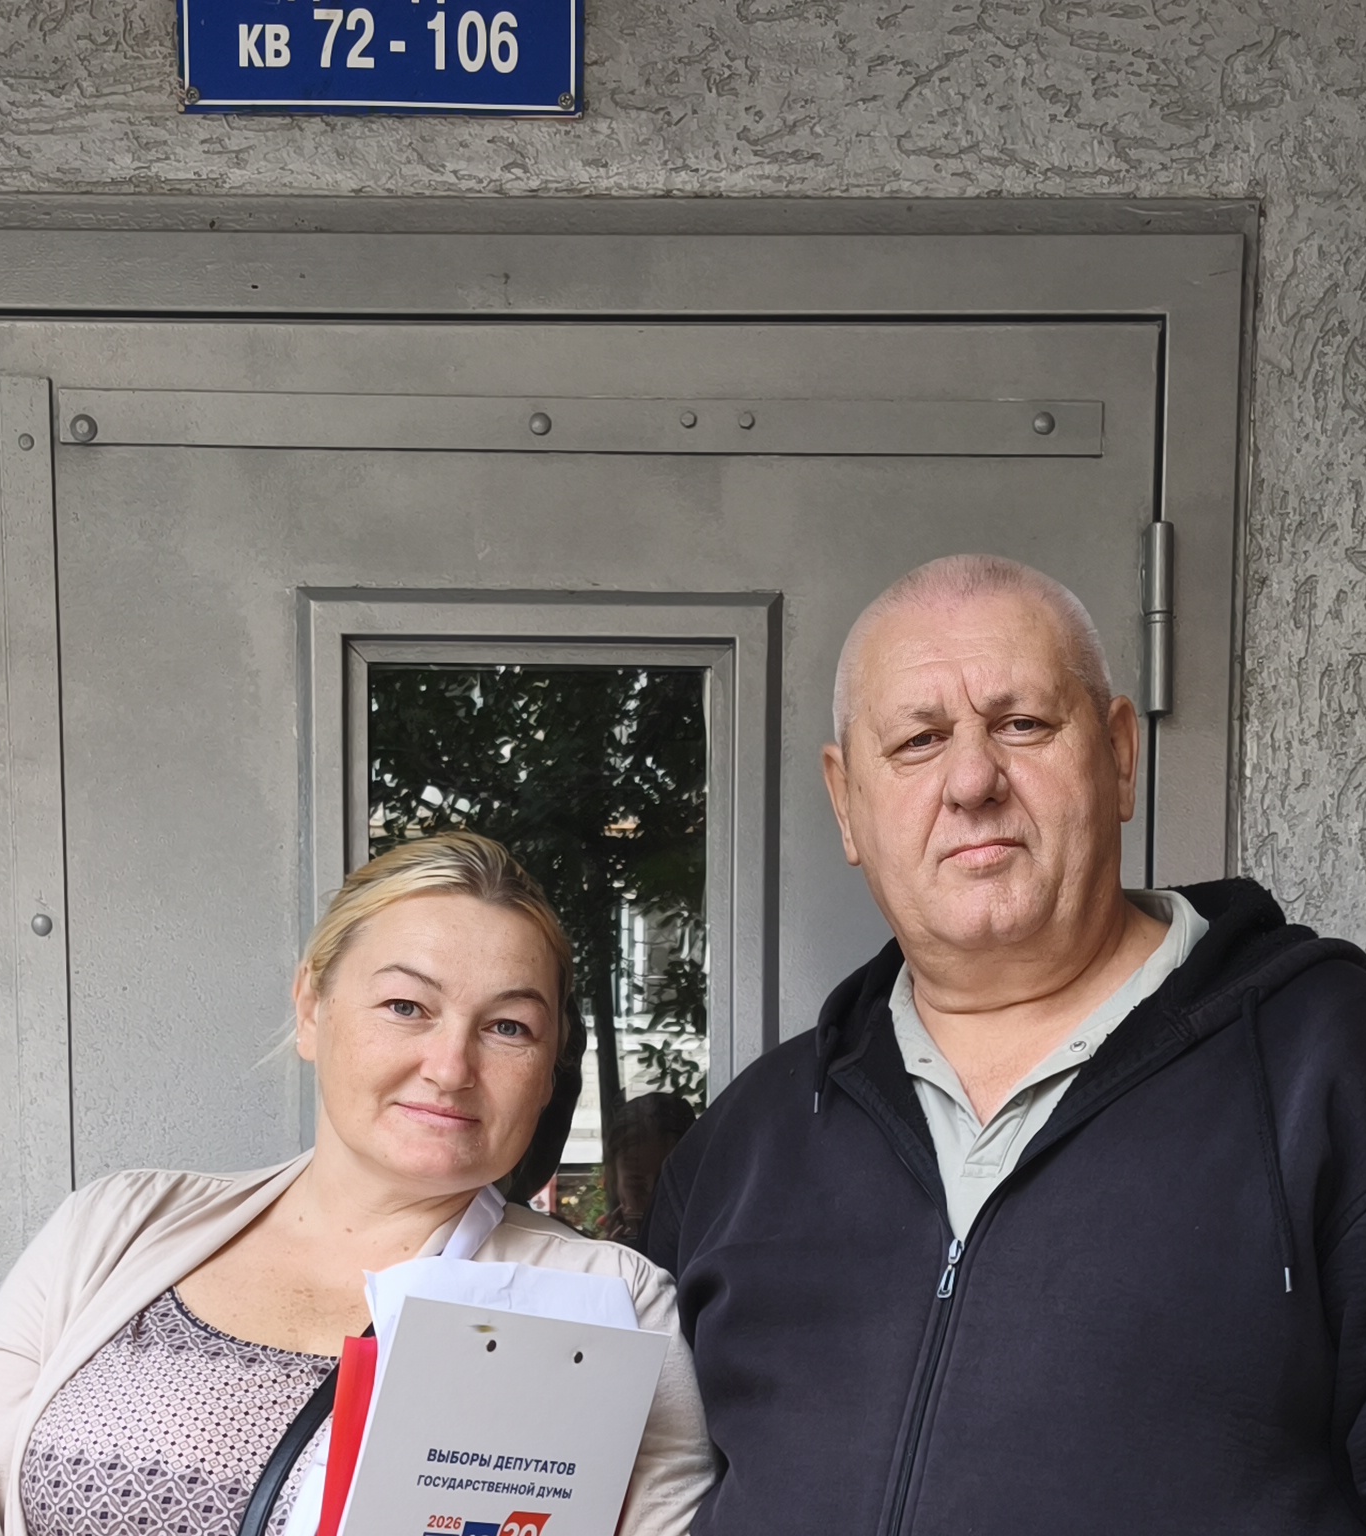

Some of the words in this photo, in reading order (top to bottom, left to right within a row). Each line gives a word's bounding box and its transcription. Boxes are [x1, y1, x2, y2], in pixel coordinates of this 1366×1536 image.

[313, 8, 375, 69] 72
[427, 11, 519, 74] 106
[426, 1448, 492, 1468] ВЫБОРЫ
[492, 1455, 577, 1476] ДЕПУТАТОВ
[416, 1474, 536, 1496] ГОСУДАРСТВЕННОЙ
[535, 1487, 573, 1499] ДУМЫ
[426, 1514, 463, 1530] 2026
